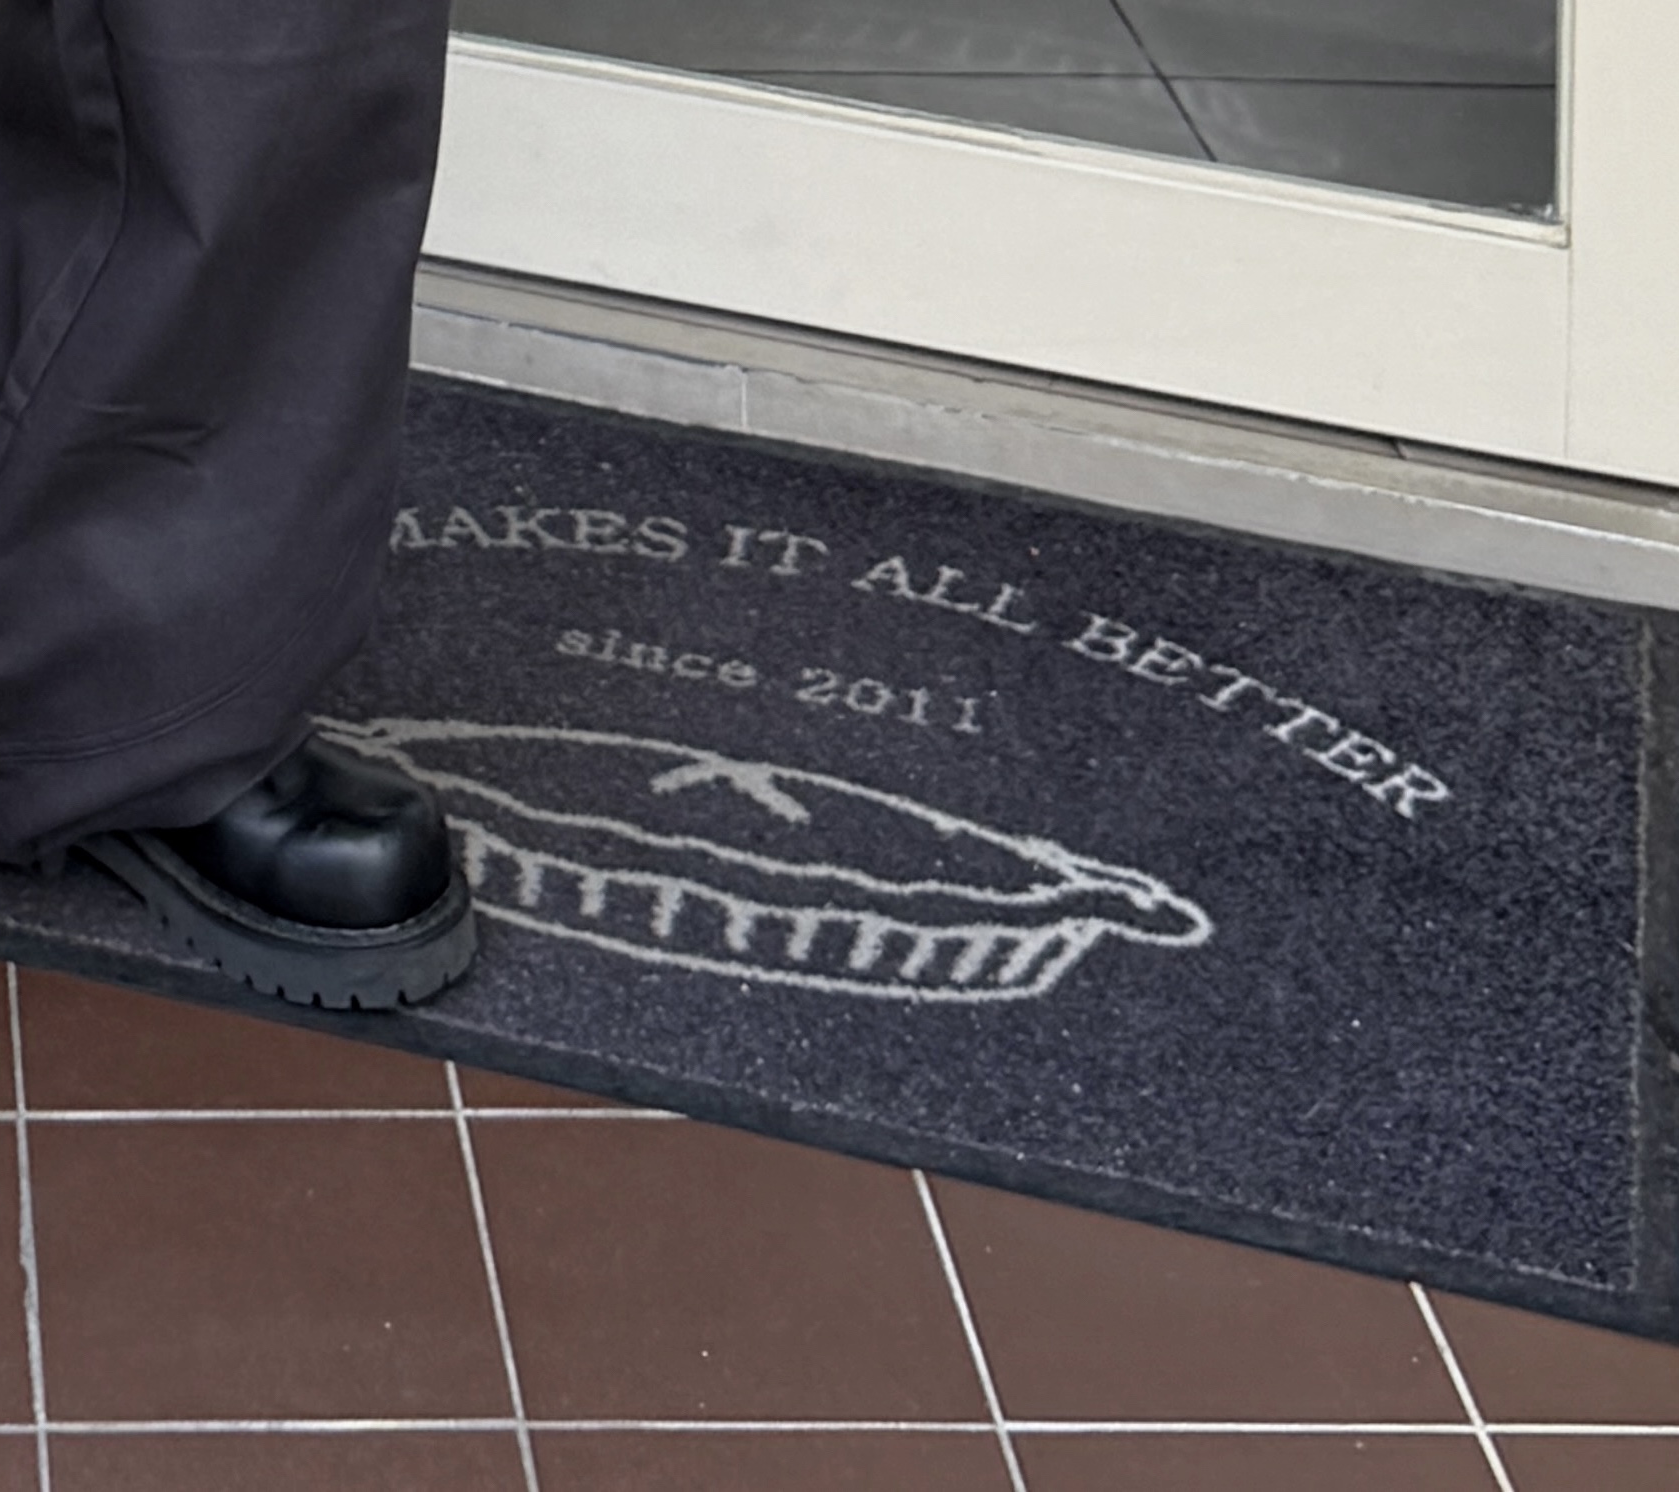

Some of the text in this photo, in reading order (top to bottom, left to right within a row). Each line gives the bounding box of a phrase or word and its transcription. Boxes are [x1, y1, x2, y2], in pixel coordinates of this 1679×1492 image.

[556, 628, 983, 734] since 2011
[721, 523, 829, 576] IT
[852, 555, 1037, 634] ALL
[1062, 614, 1449, 818] BETTER
